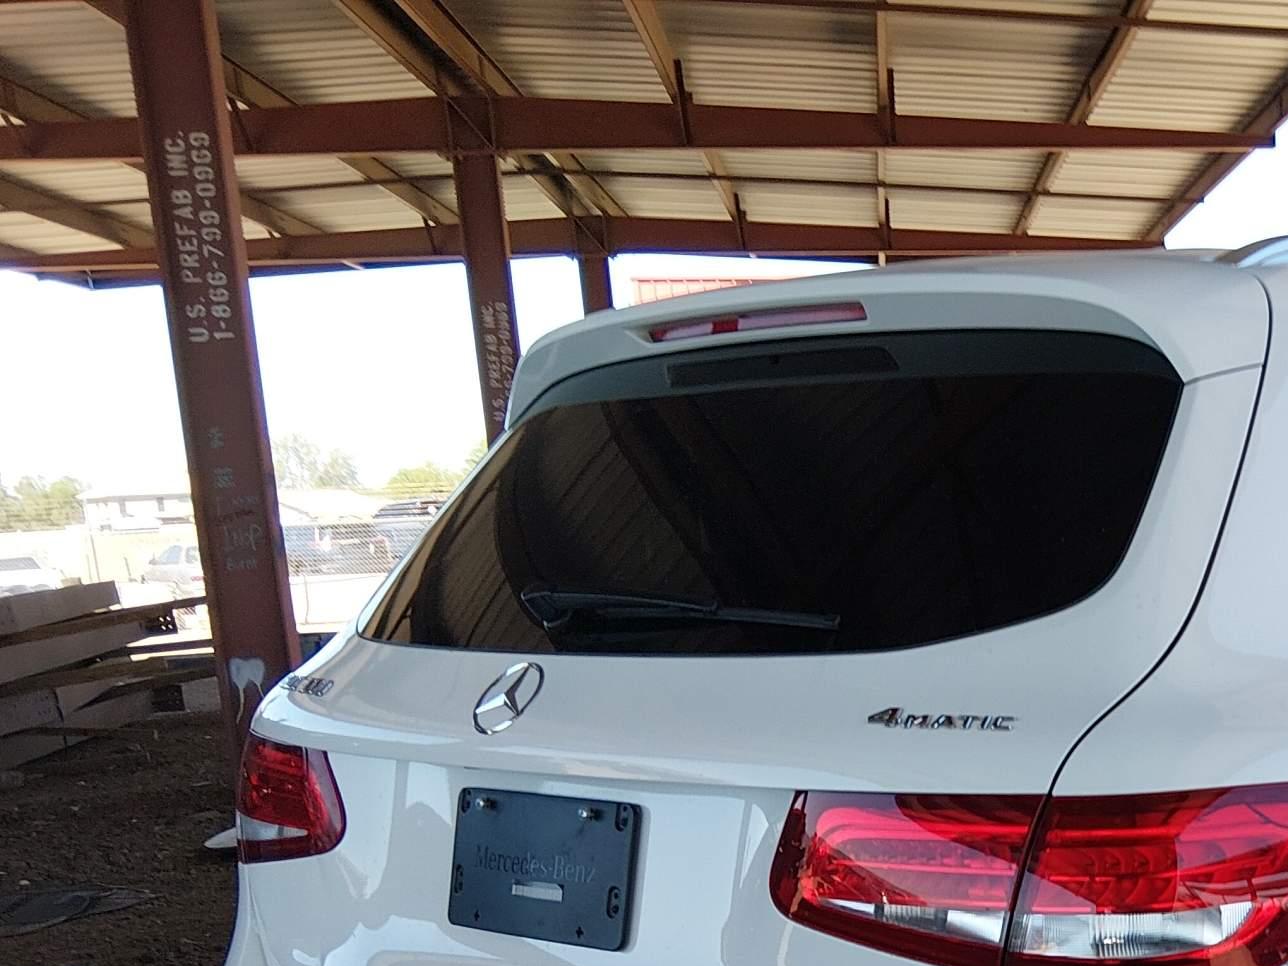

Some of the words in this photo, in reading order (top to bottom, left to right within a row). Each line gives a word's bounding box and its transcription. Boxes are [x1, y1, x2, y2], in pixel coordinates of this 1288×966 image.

[164, 131, 189, 177] INC.
[171, 189, 202, 283] PREFAB
[867, 707, 1019, 731] 4MATIC
[473, 843, 597, 884] Mercedes-Benz
